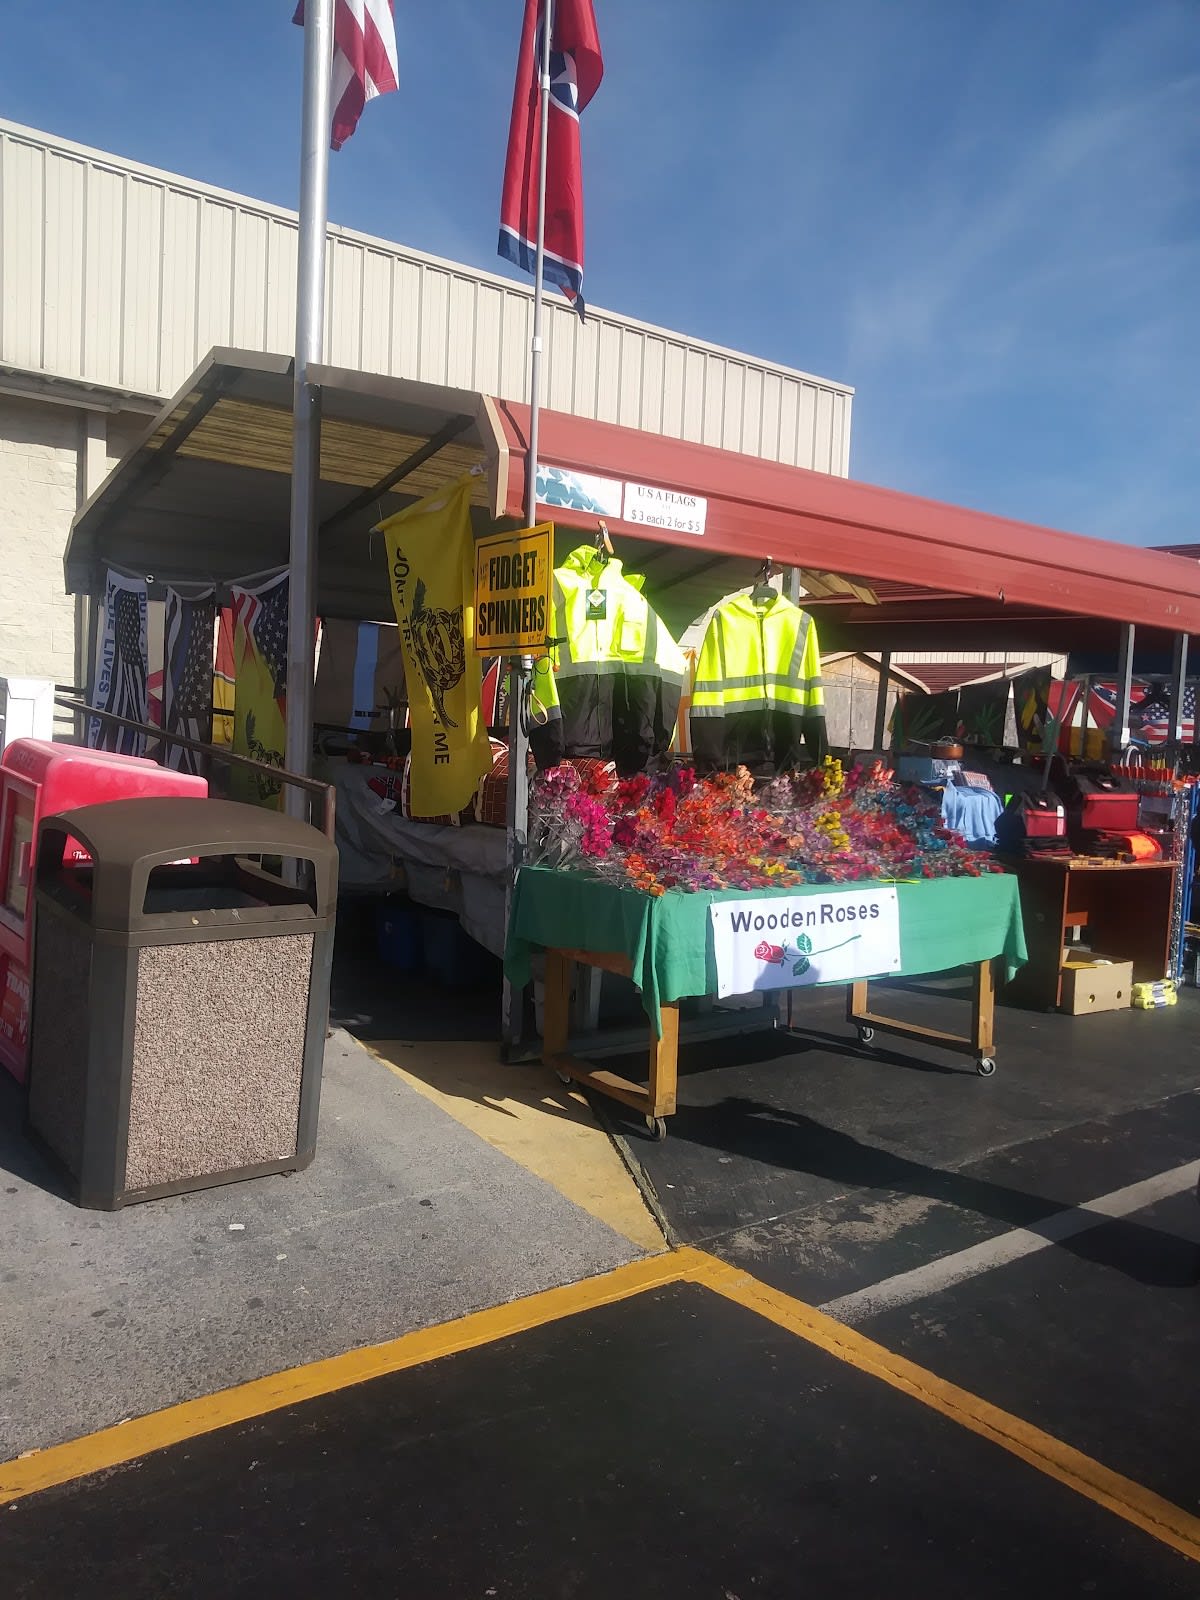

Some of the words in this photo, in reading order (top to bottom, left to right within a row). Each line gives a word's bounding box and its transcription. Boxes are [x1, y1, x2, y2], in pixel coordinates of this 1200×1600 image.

[665, 492, 697, 507] FLAGS
[646, 515, 666, 526] each
[667, 516, 673, 527] 2
[674, 517, 687, 529] for
[489, 550, 538, 591] FIDGET
[478, 595, 546, 637] SPINNERS
[98, 638, 115, 693] LIVES
[434, 732, 450, 765] ME
